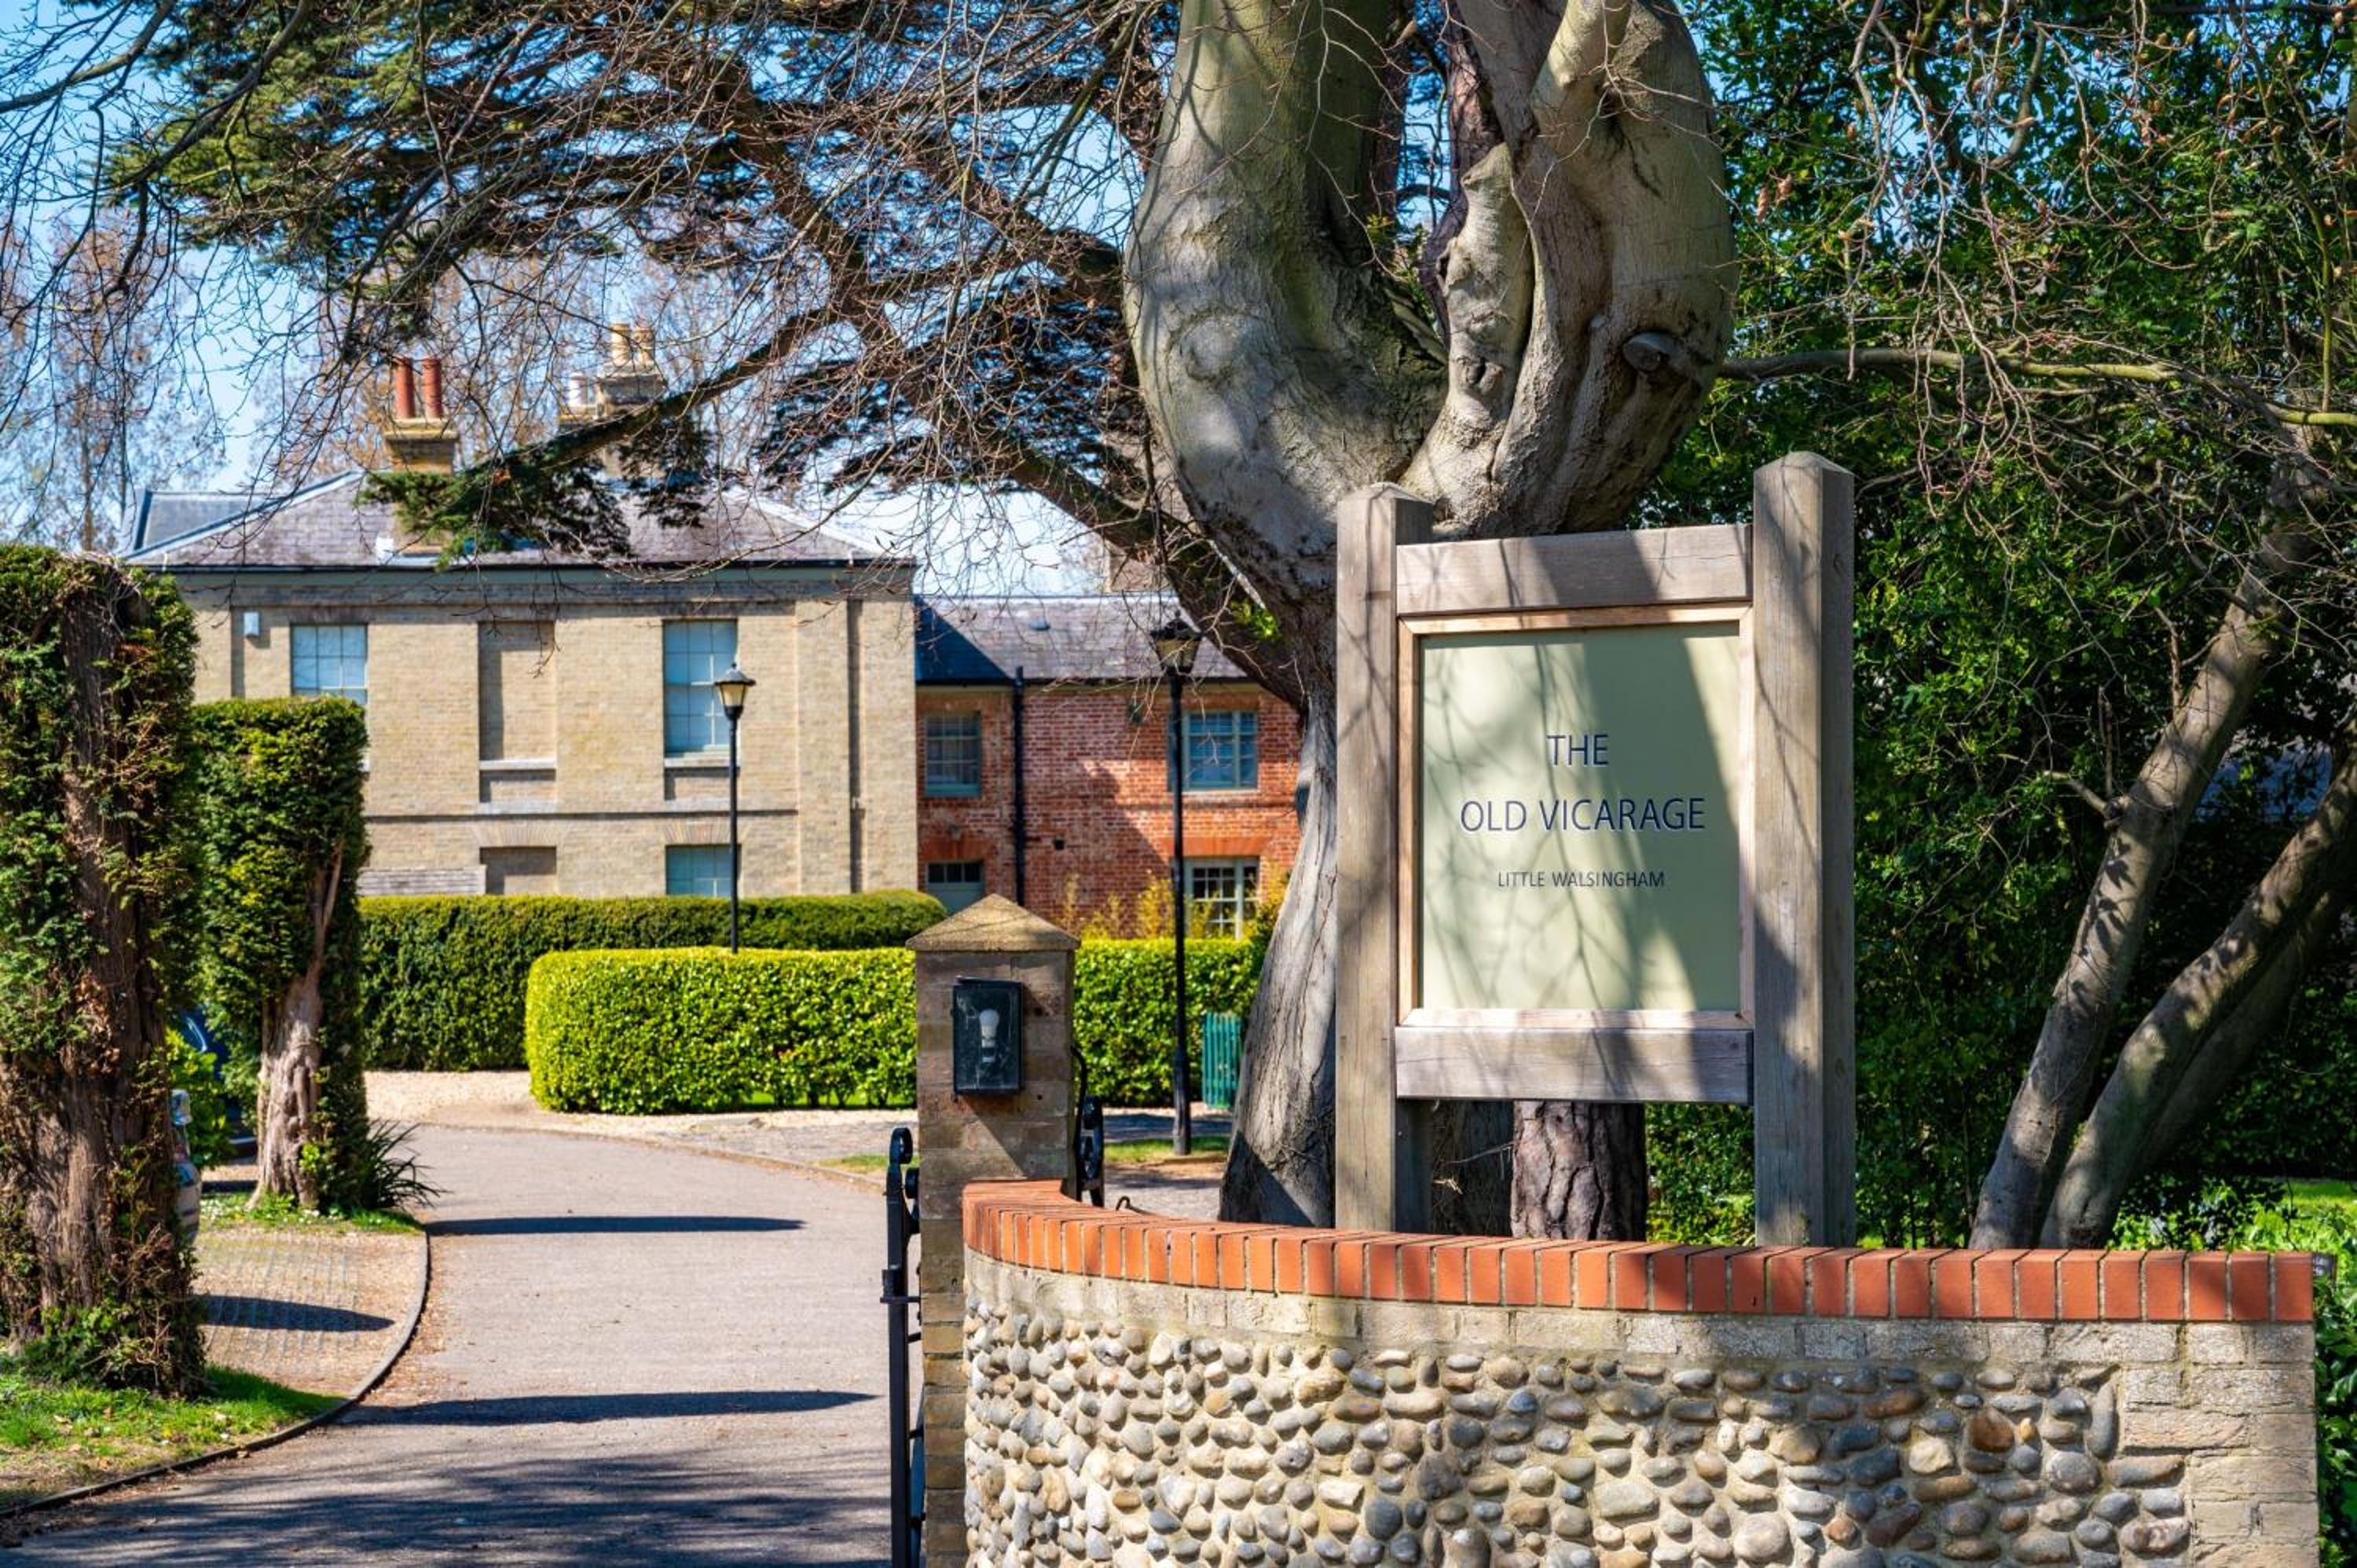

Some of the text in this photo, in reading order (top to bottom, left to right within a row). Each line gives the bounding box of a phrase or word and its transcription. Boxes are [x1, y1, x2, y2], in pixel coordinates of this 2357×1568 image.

[1546, 734, 1609, 766] THE
[1461, 797, 1705, 832] OLD VICARAGE
[1498, 871, 1665, 887] LITTLE WALSINGHAM
